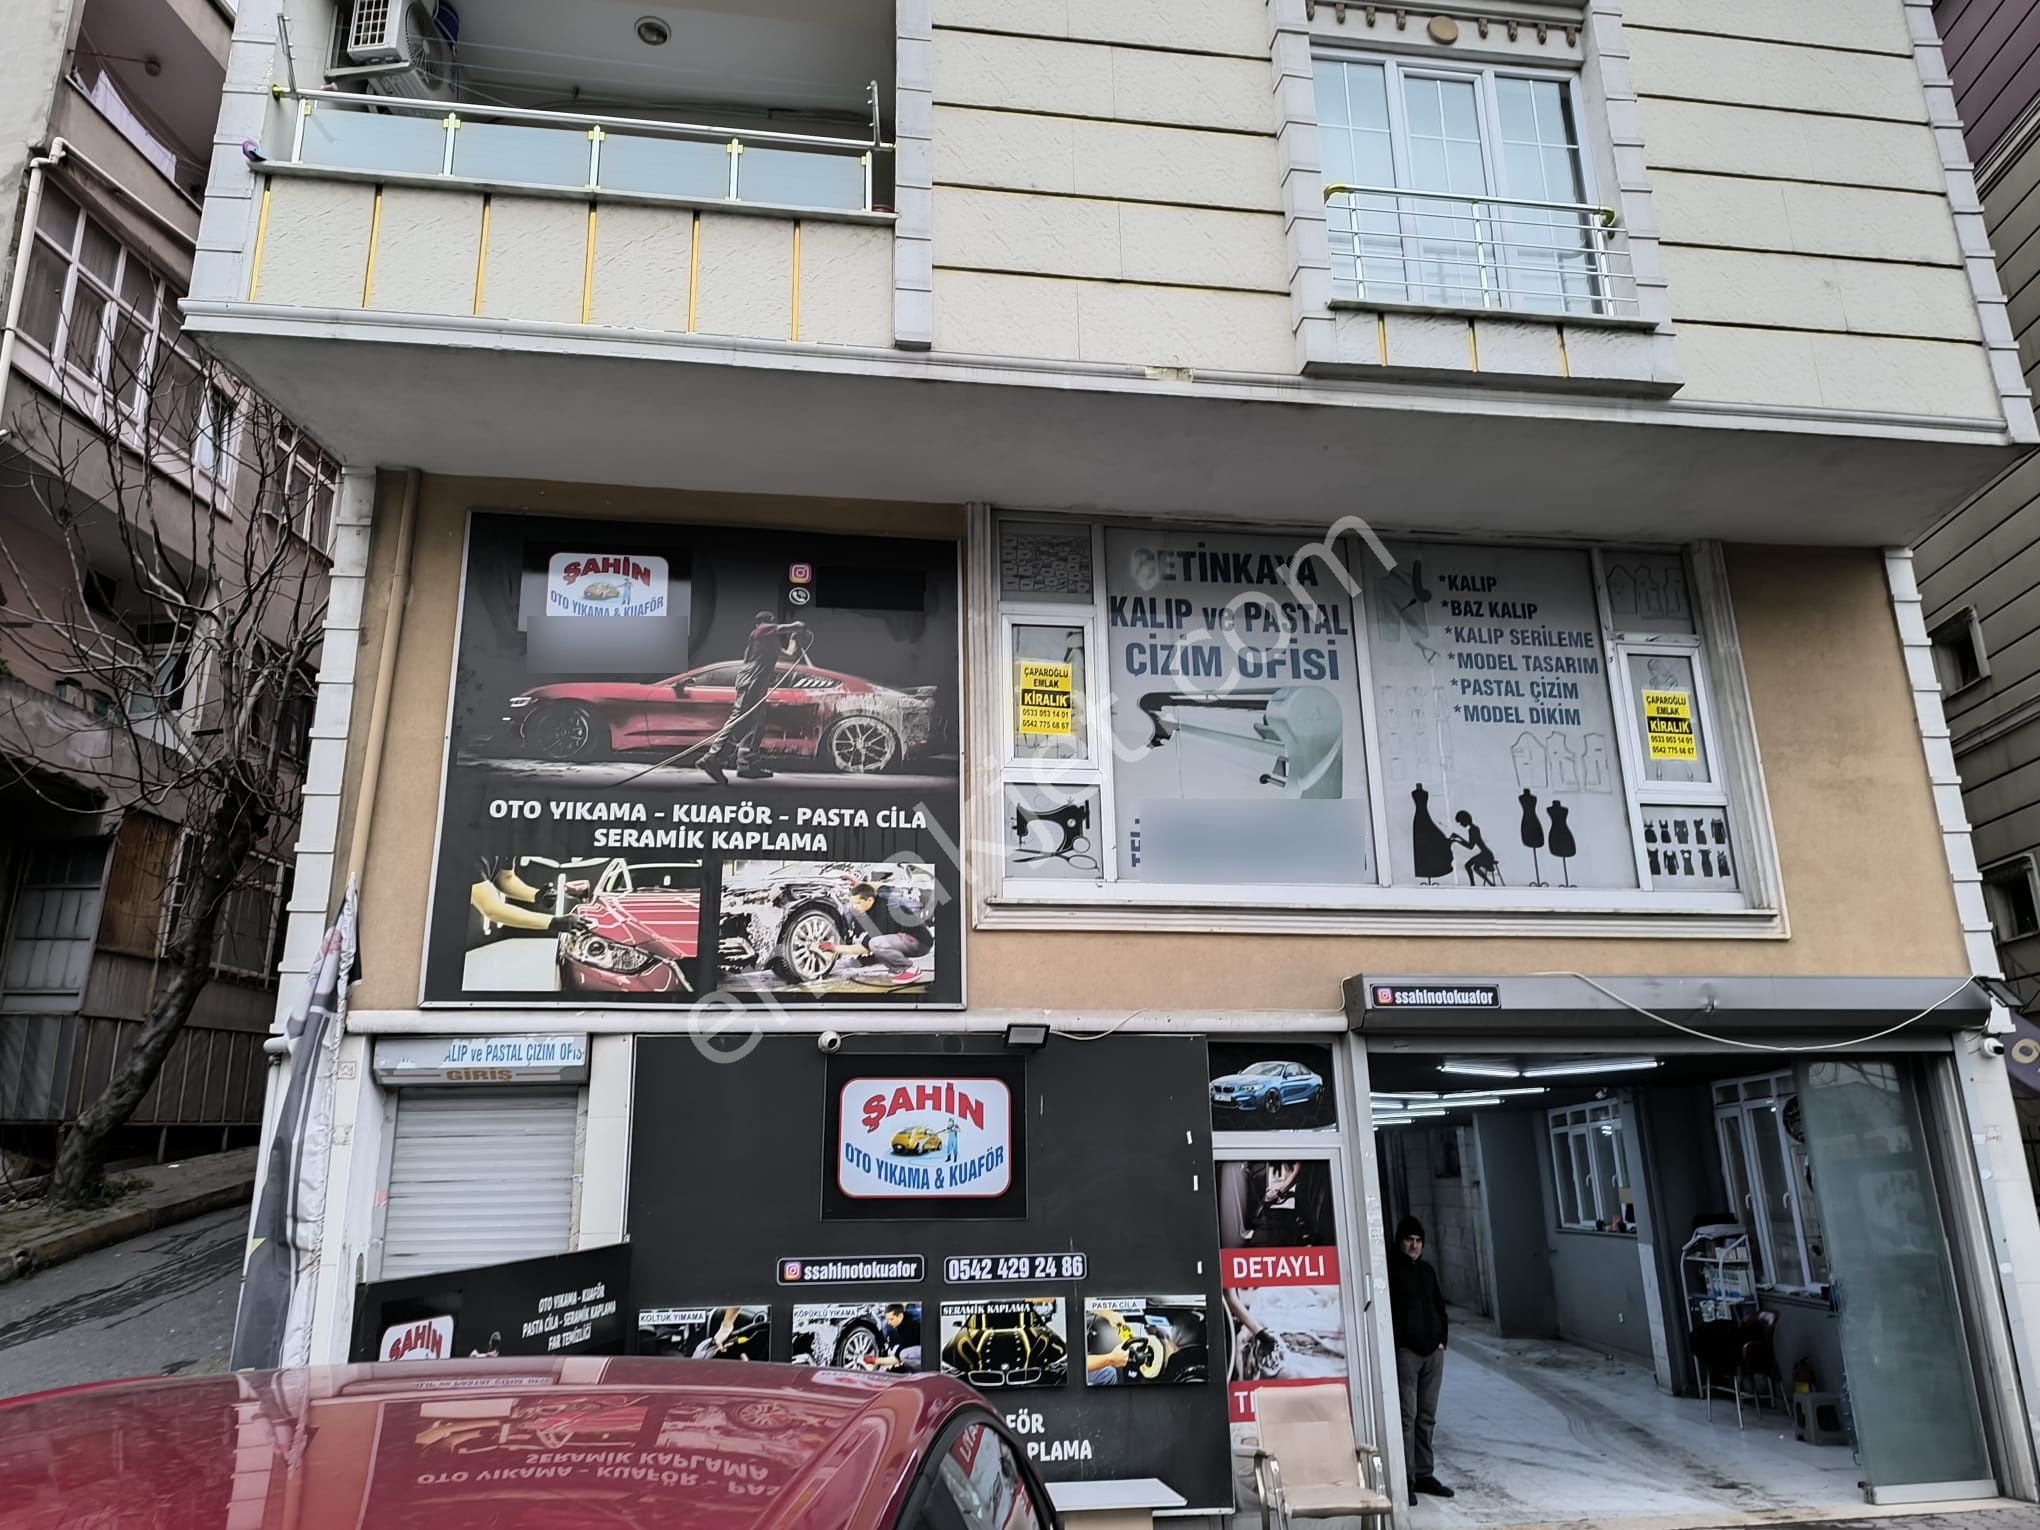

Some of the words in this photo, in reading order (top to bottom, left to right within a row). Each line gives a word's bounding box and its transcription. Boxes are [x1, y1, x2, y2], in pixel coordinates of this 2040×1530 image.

[563, 556, 651, 586] ŞAHİN
[551, 590, 569, 610] OTO
[1488, 602, 1538, 620] KALIP
[1110, 596, 1193, 629] KALIP
[1202, 606, 1234, 631] ve
[1244, 601, 1349, 636] PASTAL
[1509, 624, 1594, 649] SERİLEME
[1125, 633, 1223, 677] ÇİZİM
[1238, 637, 1340, 681] OFİSİ
[1522, 654, 1599, 675] TASARIM
[1024, 667, 1069, 678] ÇAPAROĞLU
[1033, 678, 1060, 688] EMLAK
[1024, 690, 1068, 707] KİRALIK
[1530, 675, 1579, 703] ÇİZİM
[1529, 702, 1581, 726] DİKİM
[1656, 706, 1680, 716] EMLAK
[1650, 717, 1690, 733] KİRALIK
[489, 800, 542, 819] OTO
[550, 801, 647, 821] YIKAMA
[672, 801, 772, 824] KUAFÖR
[796, 807, 869, 827] PASTA
[876, 806, 927, 829] CİLA
[593, 825, 704, 849] SERAMİK
[711, 831, 828, 851] KAPLAMA
[1395, 988, 1493, 1005] ssahinotokuafor
[471, 1048, 483, 1062] ve
[485, 1043, 523, 1062] PASTAL
[446, 1067, 513, 1083] GİRİŞ
[862, 1081, 984, 1133] ŞAHİN
[845, 1142, 871, 1174] OTO
[876, 1158, 930, 1190] YIKAMA
[934, 1168, 945, 1189] &
[949, 1145, 1004, 1188] KUAFÖR
[804, 1261, 917, 1280] ssahinotokuafor
[949, 1258, 993, 1281] 0542
[997, 1257, 1030, 1280] 429
[1035, 1256, 1057, 1278] 24
[1061, 1256, 1083, 1277] 86
[1232, 1255, 1325, 1279] DETAYLI
[538, 1296, 553, 1313] OTO
[553, 1290, 577, 1310] YIKAMA
[987, 1303, 1031, 1314] KAPLAMA
[1118, 1300, 1137, 1308] CİLA
[522, 1318, 544, 1339] PASTA
[544, 1312, 559, 1332] CİLA
[640, 1313, 672, 1323] KOLTUK
